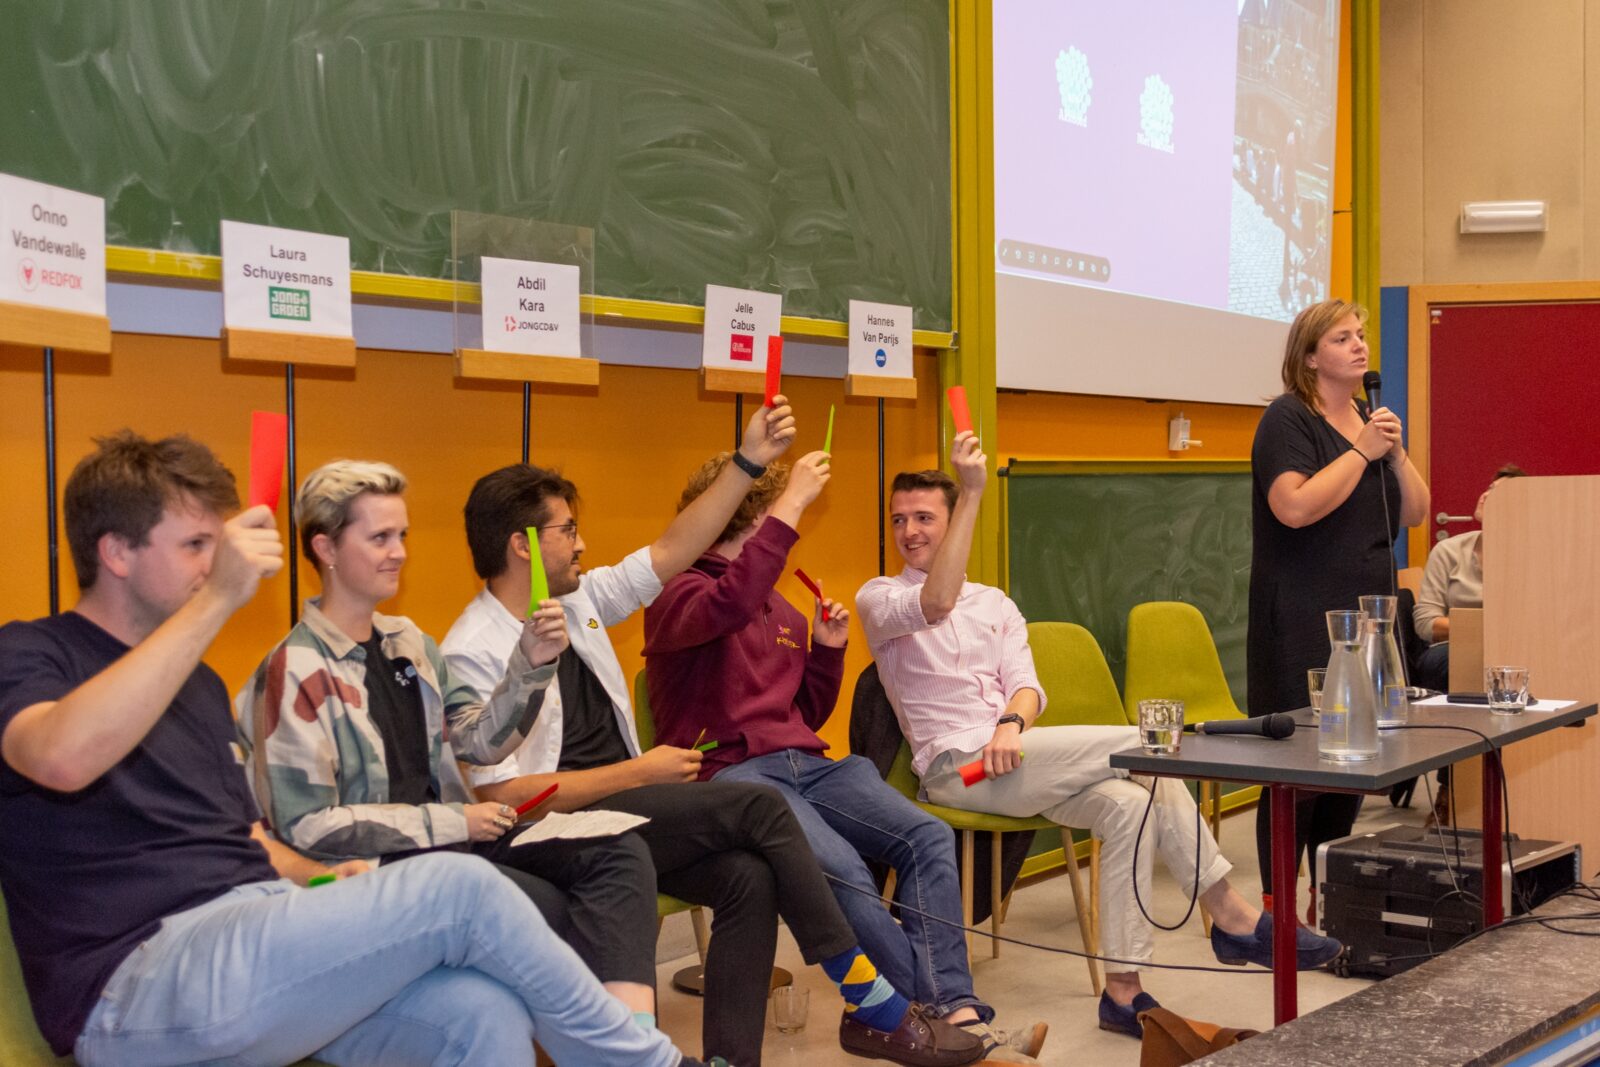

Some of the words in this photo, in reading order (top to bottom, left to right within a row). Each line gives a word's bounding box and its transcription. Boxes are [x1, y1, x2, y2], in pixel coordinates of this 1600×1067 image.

[32, 204, 68, 227] Onno
[12, 229, 86, 260] Vandewalle
[270, 245, 307, 262] Laura
[41, 269, 82, 289] REDFOX
[243, 264, 333, 286] Schuyesmans
[517, 276, 546, 291] Abdil
[519, 298, 545, 312] Kara
[735, 302, 754, 314] Jelle
[518, 321, 559, 332] JONGCD&V
[731, 319, 756, 332] Cabus
[867, 314, 895, 327] Hannes
[862, 331, 876, 342] Van
[878, 332, 899, 346] Parijs
